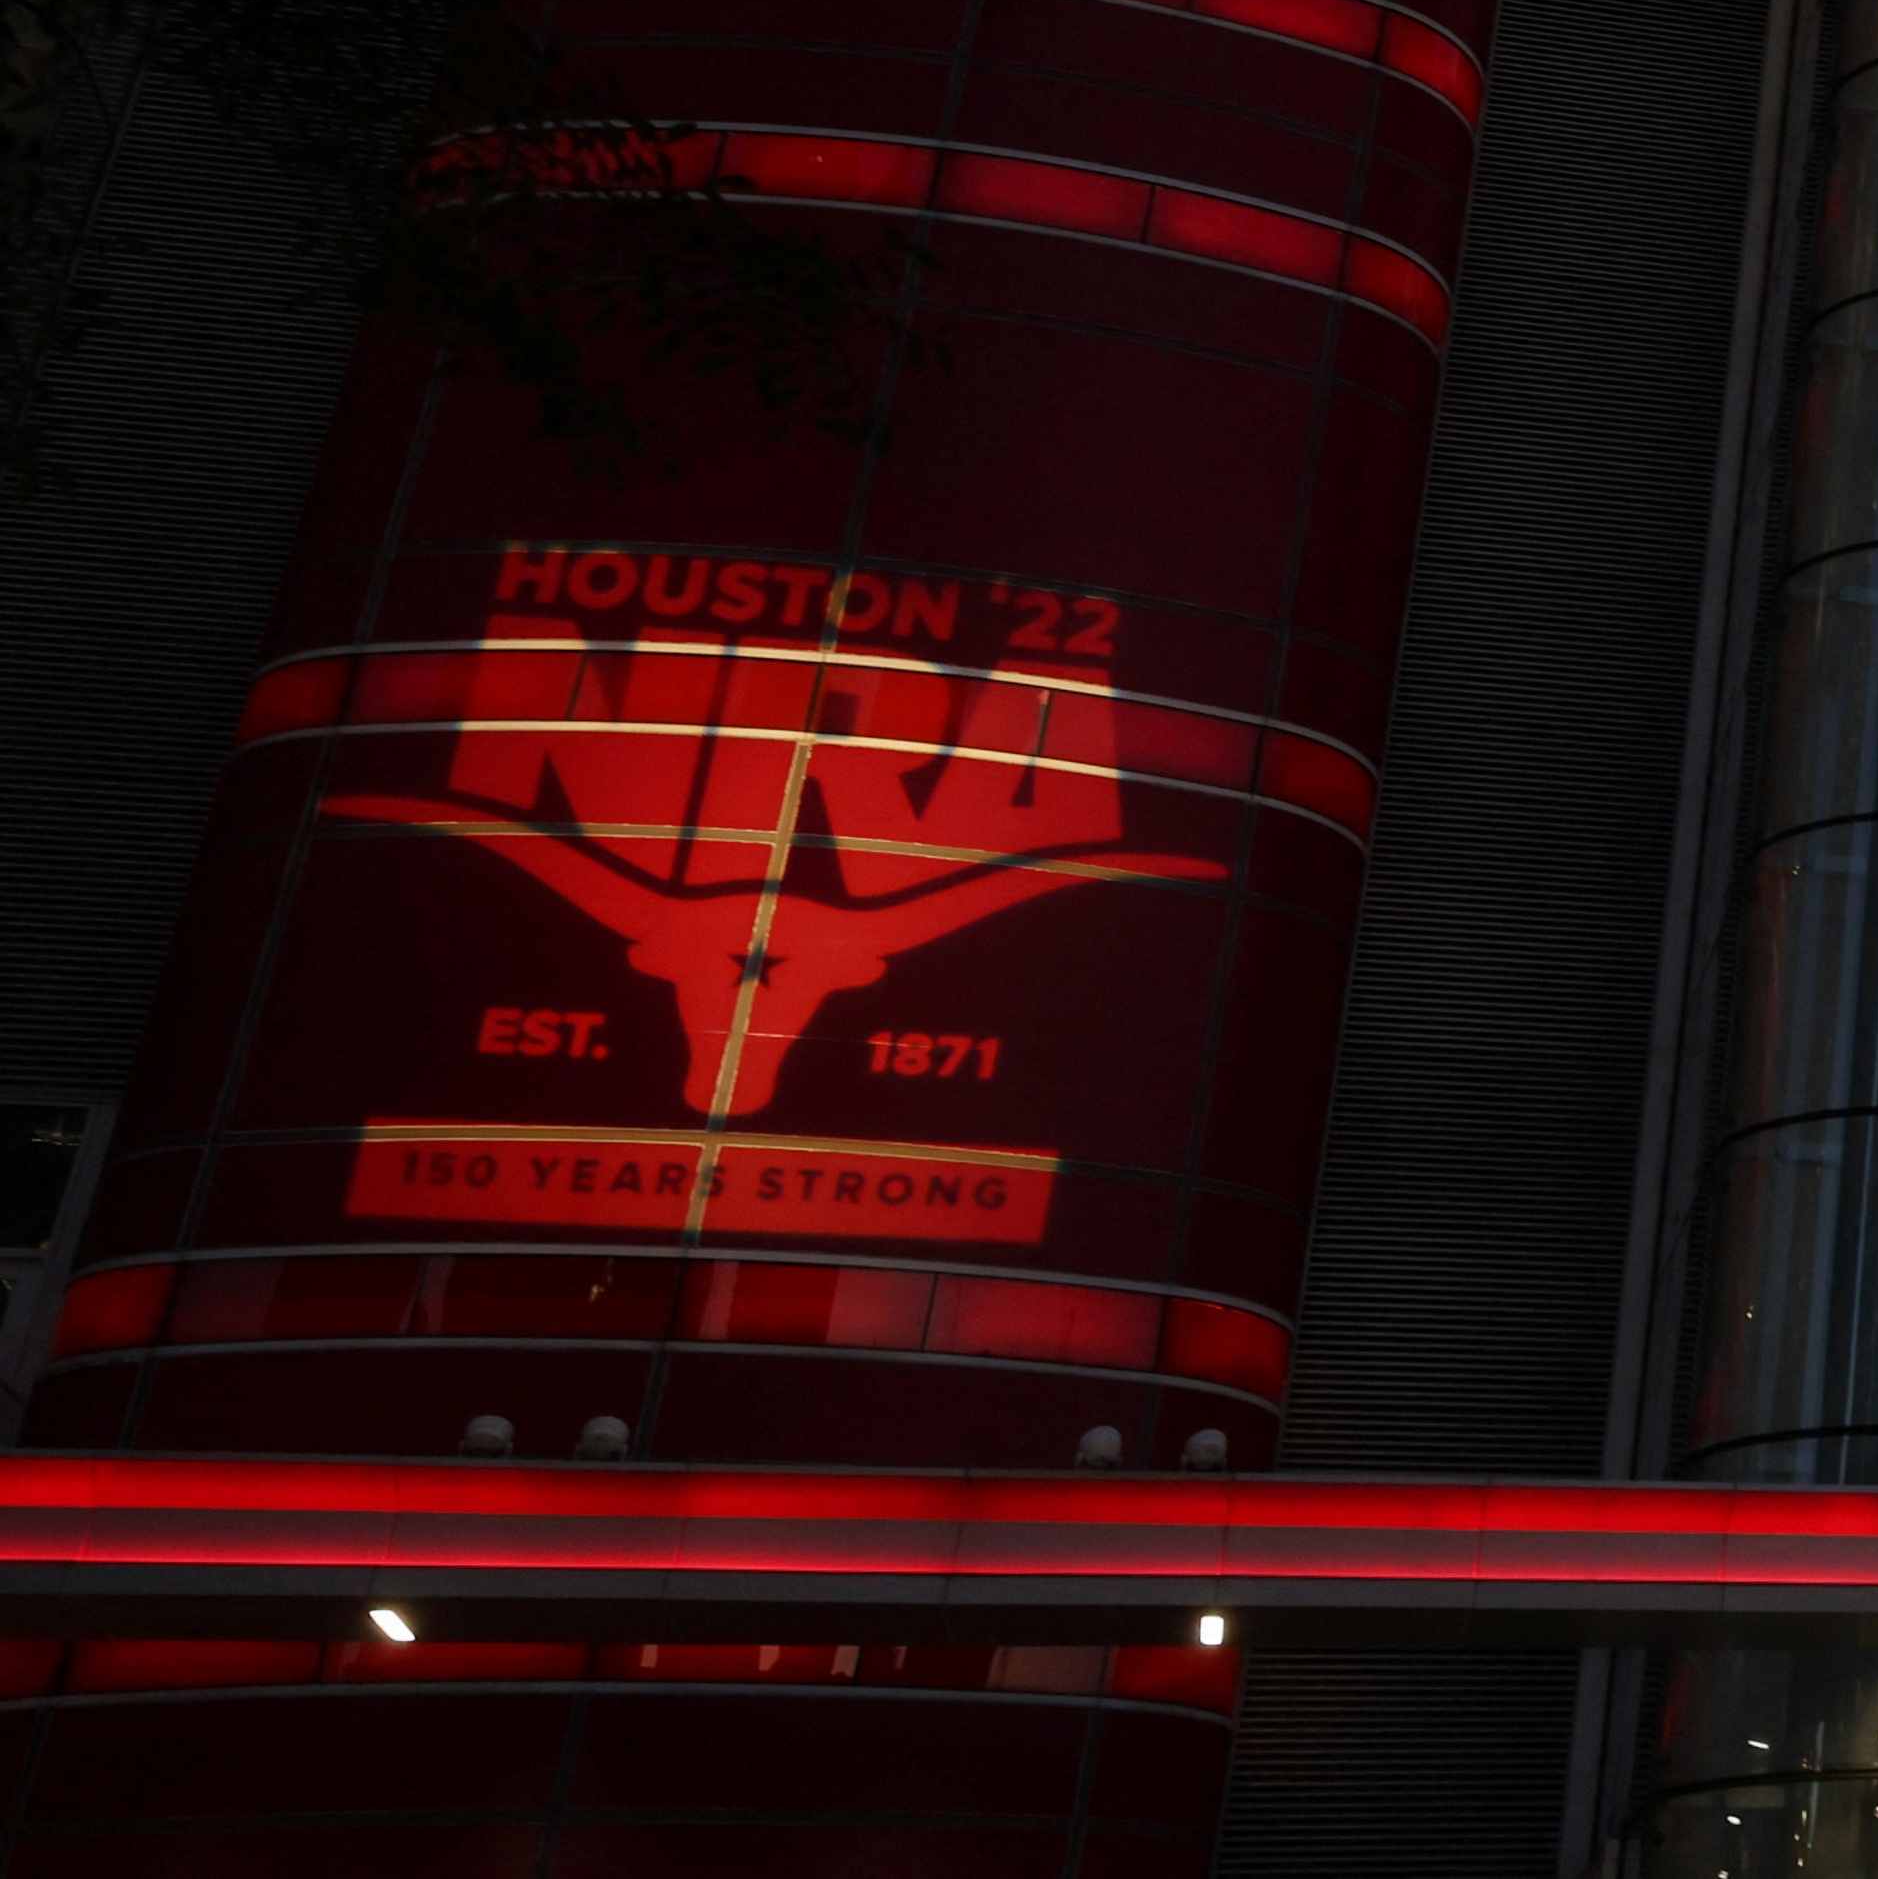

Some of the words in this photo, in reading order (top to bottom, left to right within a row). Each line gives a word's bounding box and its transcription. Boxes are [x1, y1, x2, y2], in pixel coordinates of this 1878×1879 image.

[492, 540, 964, 641] HOUSTON
[990, 574, 1122, 657] '22
[446, 614, 1124, 896] NRA
[477, 1007, 610, 1060] EST.
[868, 1030, 999, 1080] 1871
[400, 1150, 496, 1187] 150
[529, 1155, 725, 1199] YEARS
[756, 1167, 1009, 1210] STRONG
